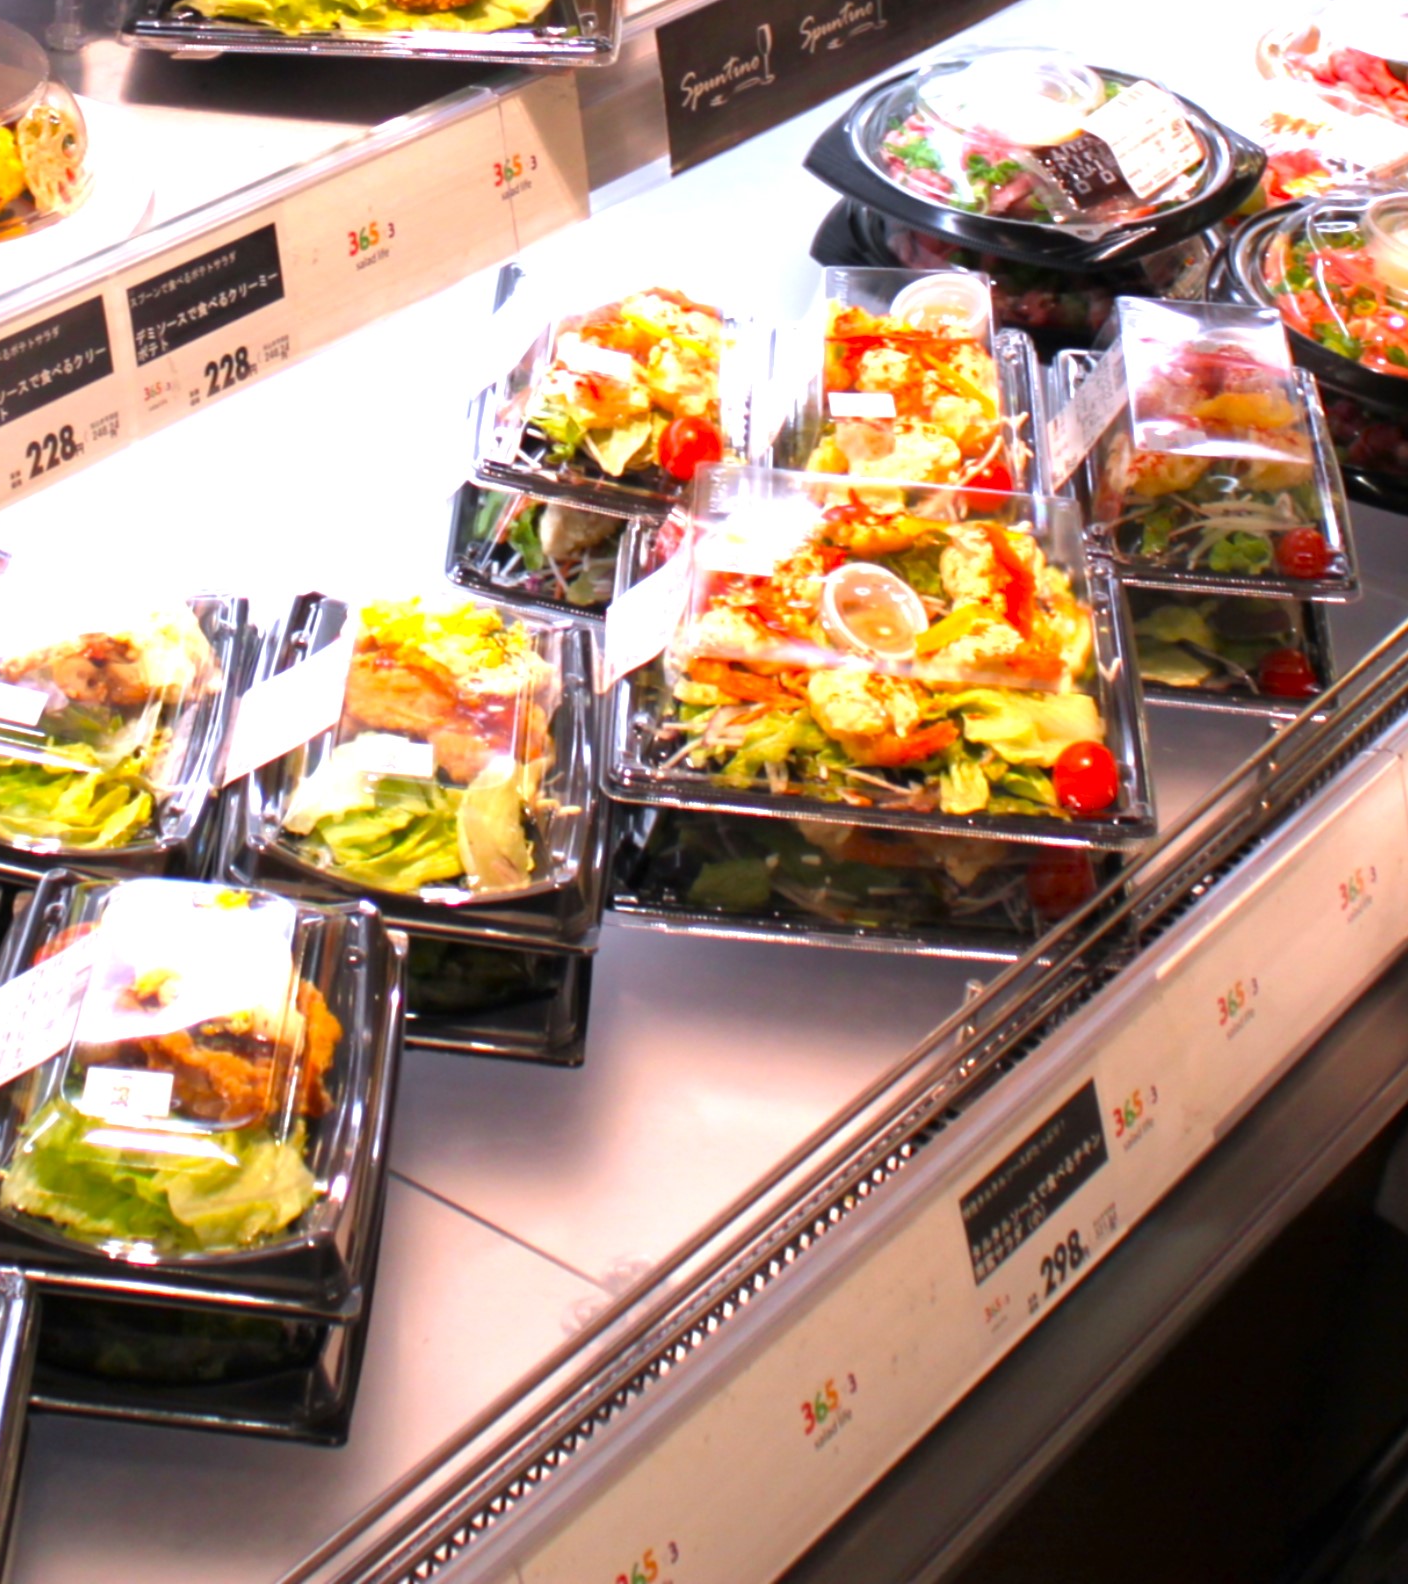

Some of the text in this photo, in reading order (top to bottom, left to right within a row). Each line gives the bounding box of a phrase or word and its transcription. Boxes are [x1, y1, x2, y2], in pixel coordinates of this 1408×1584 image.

[800, 1, 874, 54] Spuntino
[680, 55, 760, 112] Spuntino
[493, 153, 524, 187] 365
[348, 221, 380, 257] 365
[1218, 981, 1245, 1027] 365
[1113, 1088, 1143, 1138] 365
[801, 1377, 839, 1436] 365
[616, 1548, 659, 1584] 65
